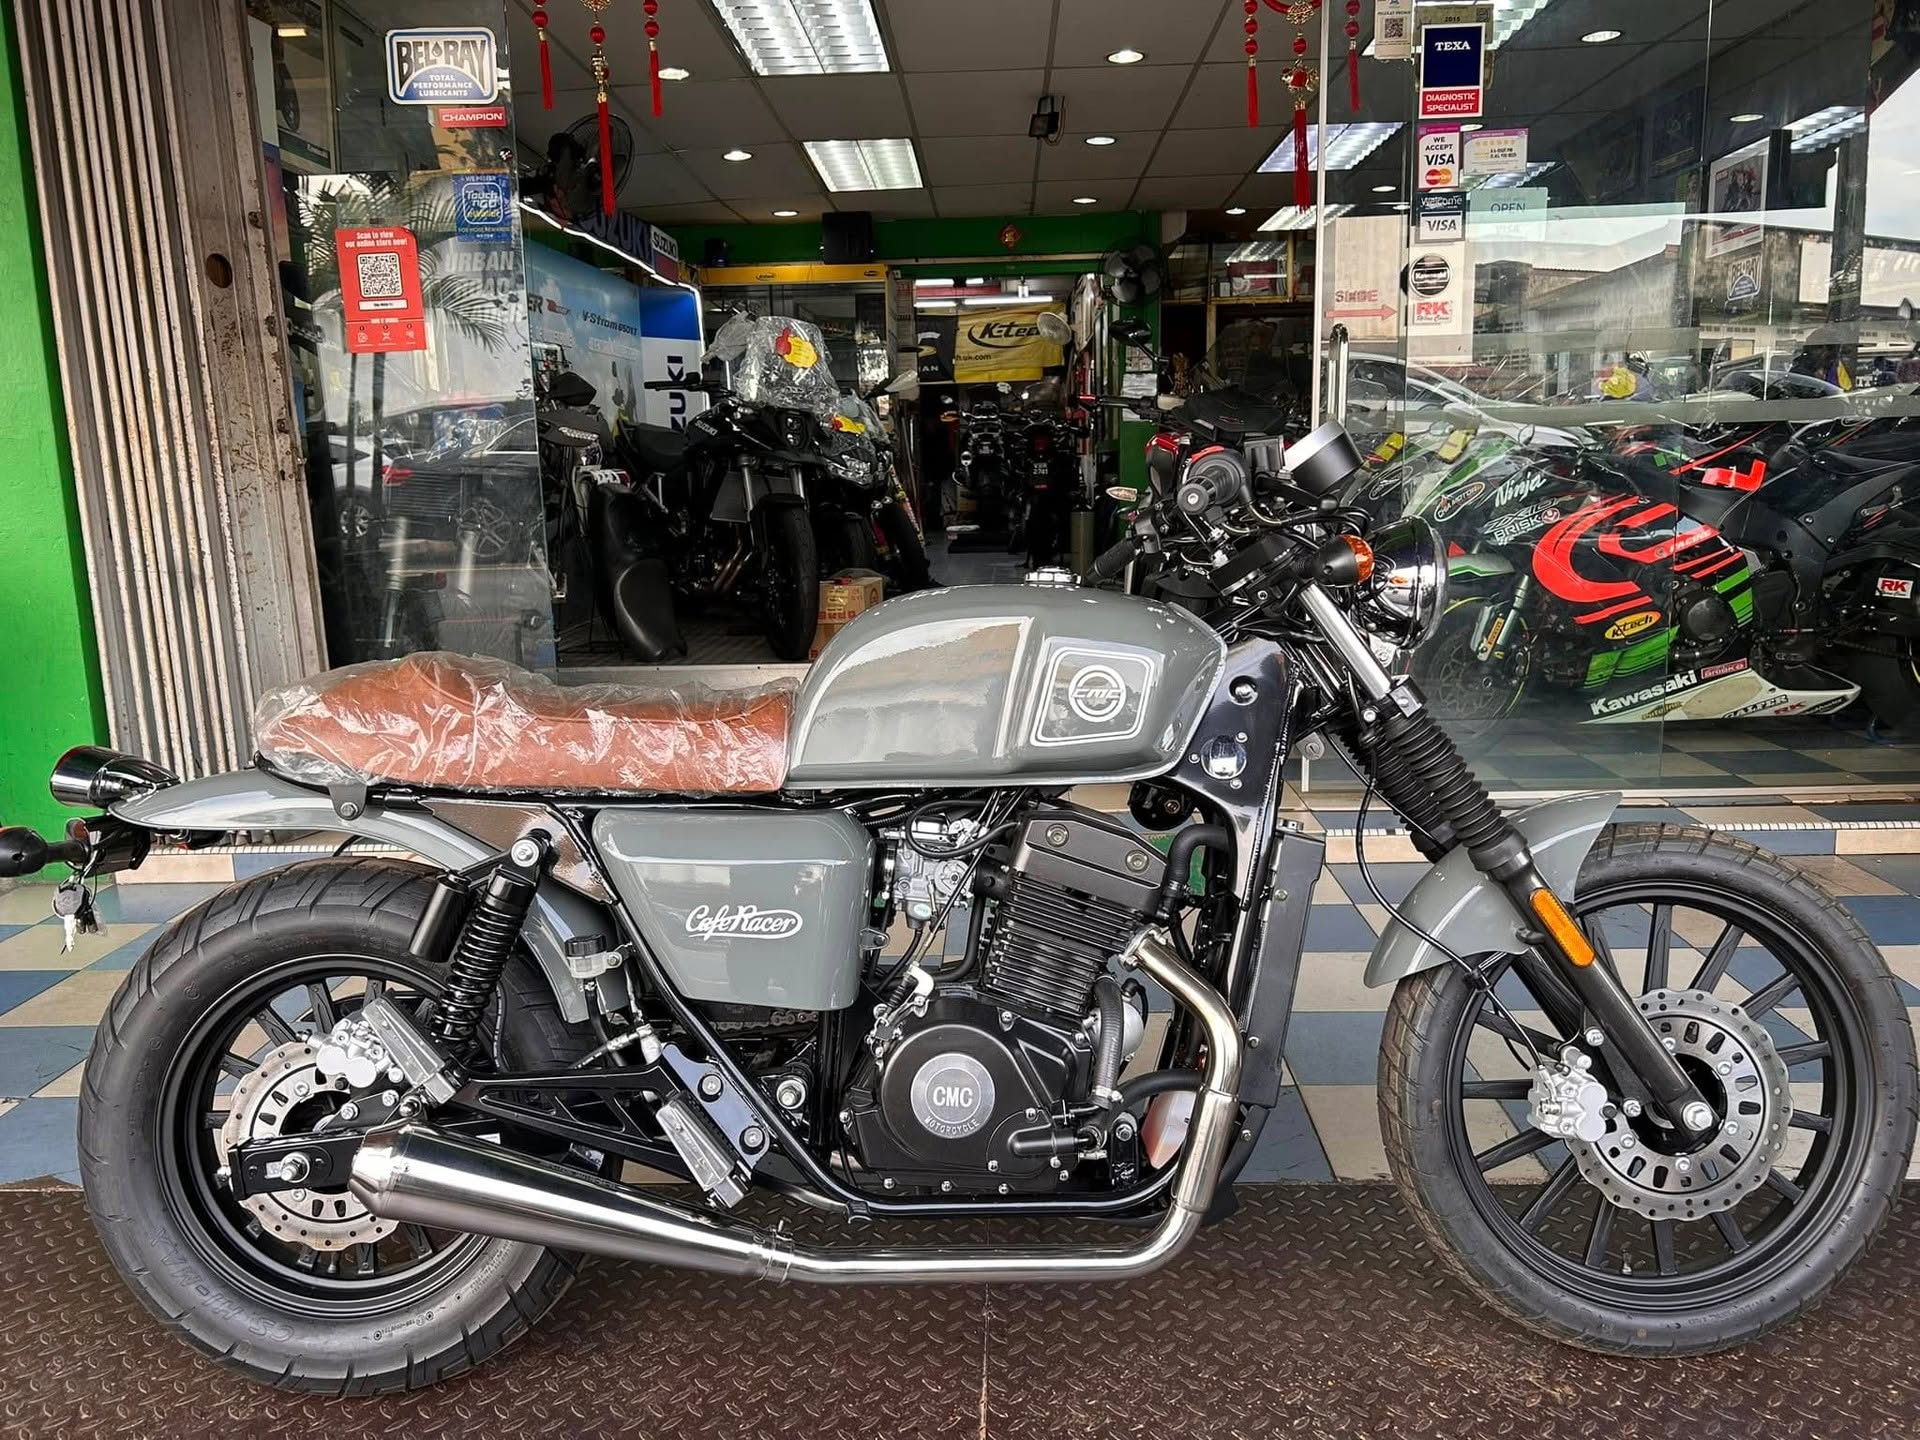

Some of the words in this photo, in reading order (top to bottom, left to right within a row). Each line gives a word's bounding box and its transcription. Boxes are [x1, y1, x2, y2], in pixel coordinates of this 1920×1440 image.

[1434, 40, 1471, 51] TEXA
[1425, 92, 1476, 102] DIAGNOSTIC
[1426, 103, 1474, 112] SPECIALIST
[442, 113, 503, 121] CHAMPION
[1424, 153, 1455, 166] VISA
[465, 190, 498, 199] Touch
[1490, 202, 1526, 213] OPEN
[1427, 220, 1457, 231] VISA
[444, 251, 514, 272] URBAN
[1416, 302, 1449, 315] RK
[1487, 471, 1547, 508] Ninja
[1494, 514, 1541, 542] BRISK
[1880, 580, 1908, 592] RK
[1590, 669, 1698, 716] Kawasaki
[932, 1086, 974, 1108] CMC
[924, 1115, 980, 1136] MOTORCYCLE
